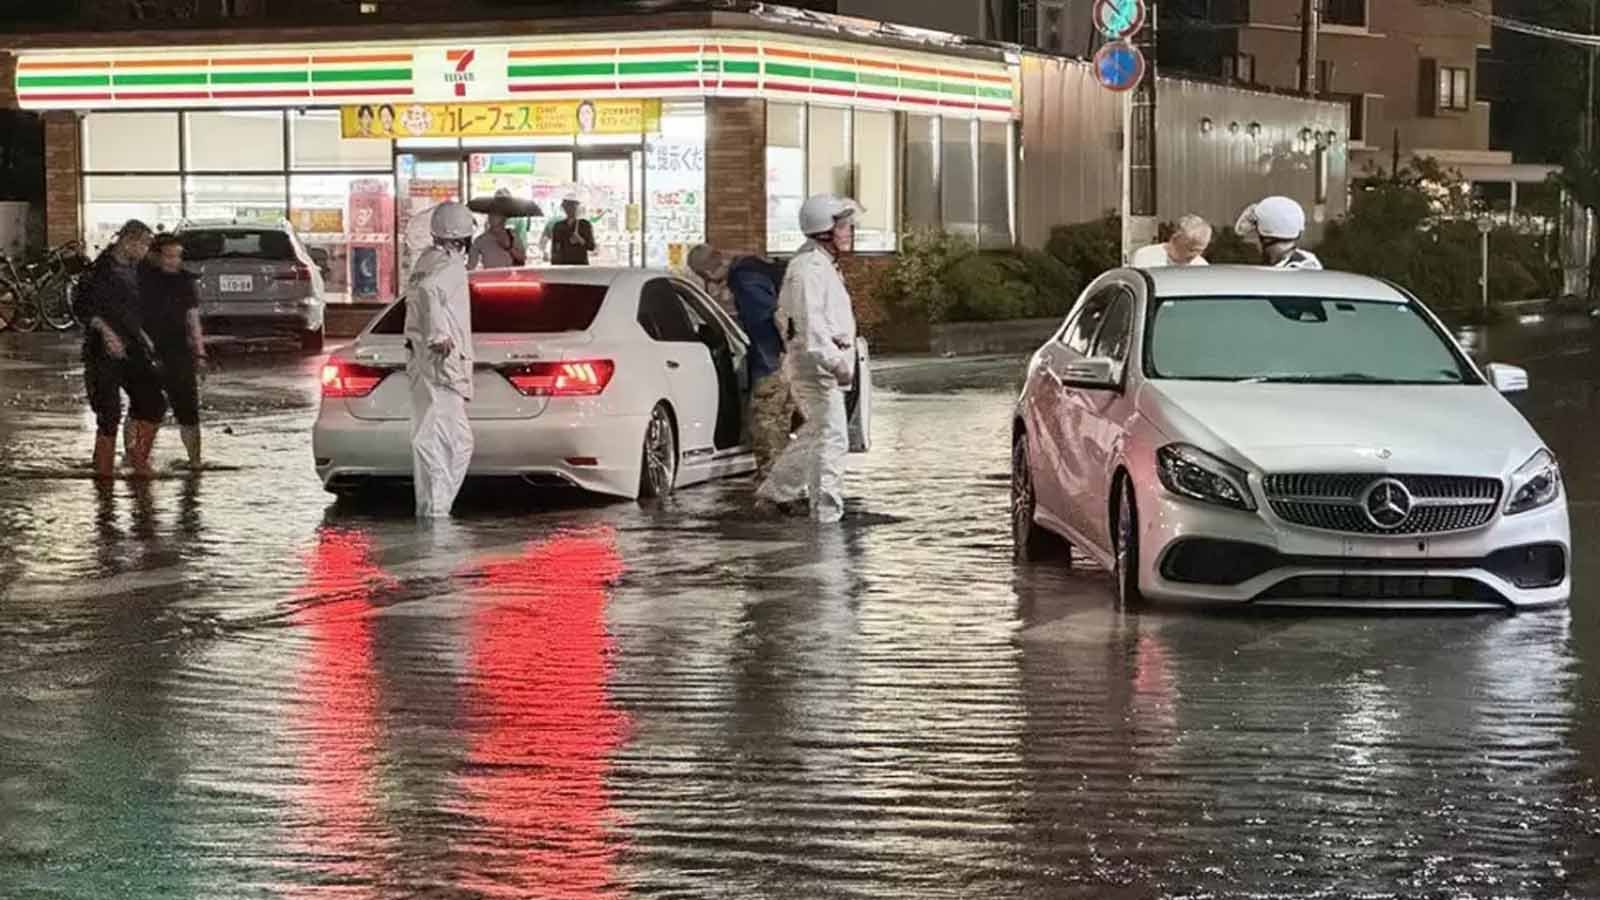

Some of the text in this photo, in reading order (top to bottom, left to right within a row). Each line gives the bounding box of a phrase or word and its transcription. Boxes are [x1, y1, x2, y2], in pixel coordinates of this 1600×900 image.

[447, 49, 475, 96] 7
[440, 104, 533, 132] カレーフェス
